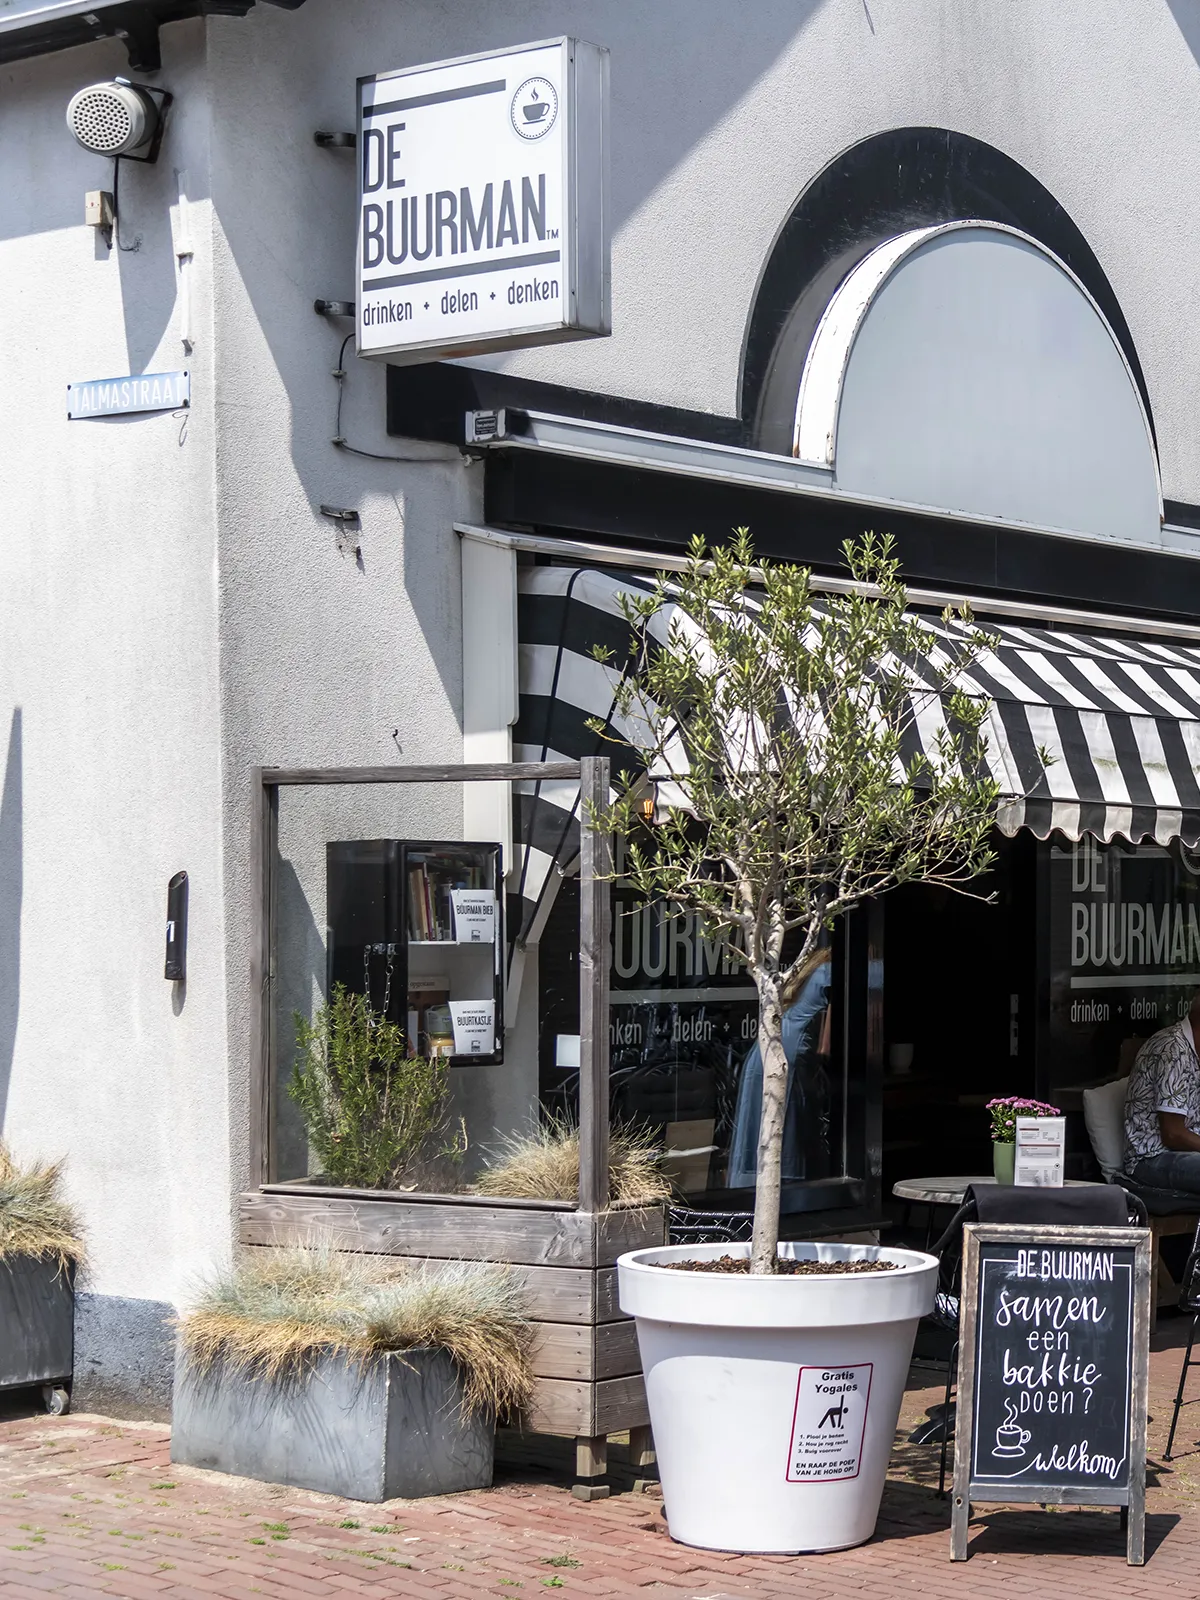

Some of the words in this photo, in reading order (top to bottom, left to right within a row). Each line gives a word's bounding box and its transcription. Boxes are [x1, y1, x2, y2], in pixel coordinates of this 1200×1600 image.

[363, 122, 406, 194] DE
[363, 174, 546, 269] BUURMAN
[363, 302, 412, 326] drinken
[441, 289, 478, 314] delen
[508, 278, 558, 305] denken
[73, 377, 184, 412] TALMASTRAAT
[1072, 831, 1106, 892] DE
[1071, 1000, 1110, 1023] drinken
[1130, 998, 1158, 1020] delen
[673, 1015, 712, 1042] delen
[1018, 1250, 1037, 1277] DE
[1043, 1250, 1114, 1281] BUURMAN
[1026, 1330, 1069, 1350] een
[822, 1371, 854, 1381] Gratis
[1002, 1349, 1102, 1388] bakkie
[815, 1383, 858, 1395] Yogales
